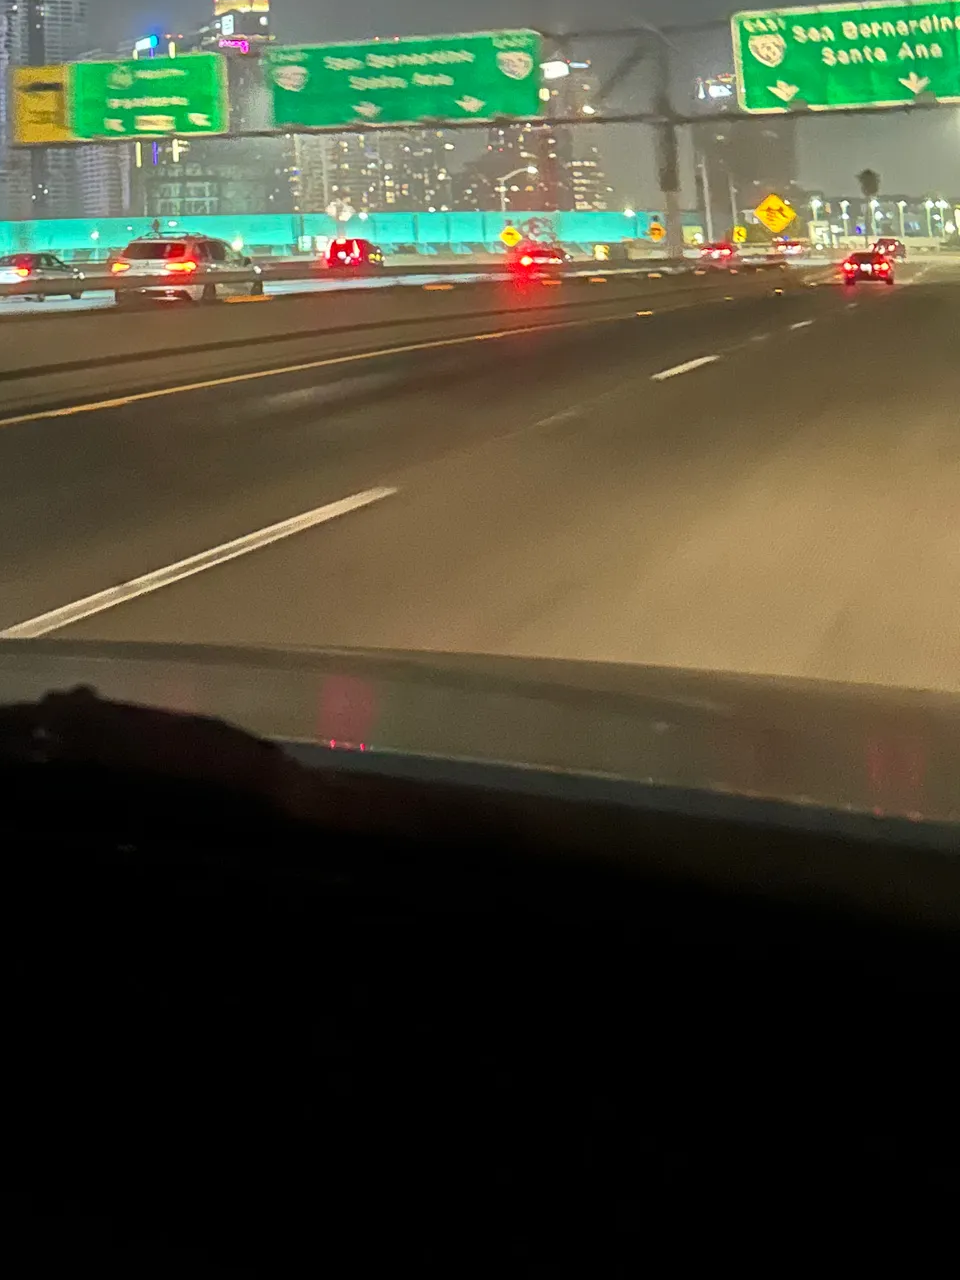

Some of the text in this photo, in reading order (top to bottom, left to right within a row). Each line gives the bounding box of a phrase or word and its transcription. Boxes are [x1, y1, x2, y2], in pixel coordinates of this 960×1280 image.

[791, 24, 835, 44] San
[821, 41, 943, 66] Santa Ana
